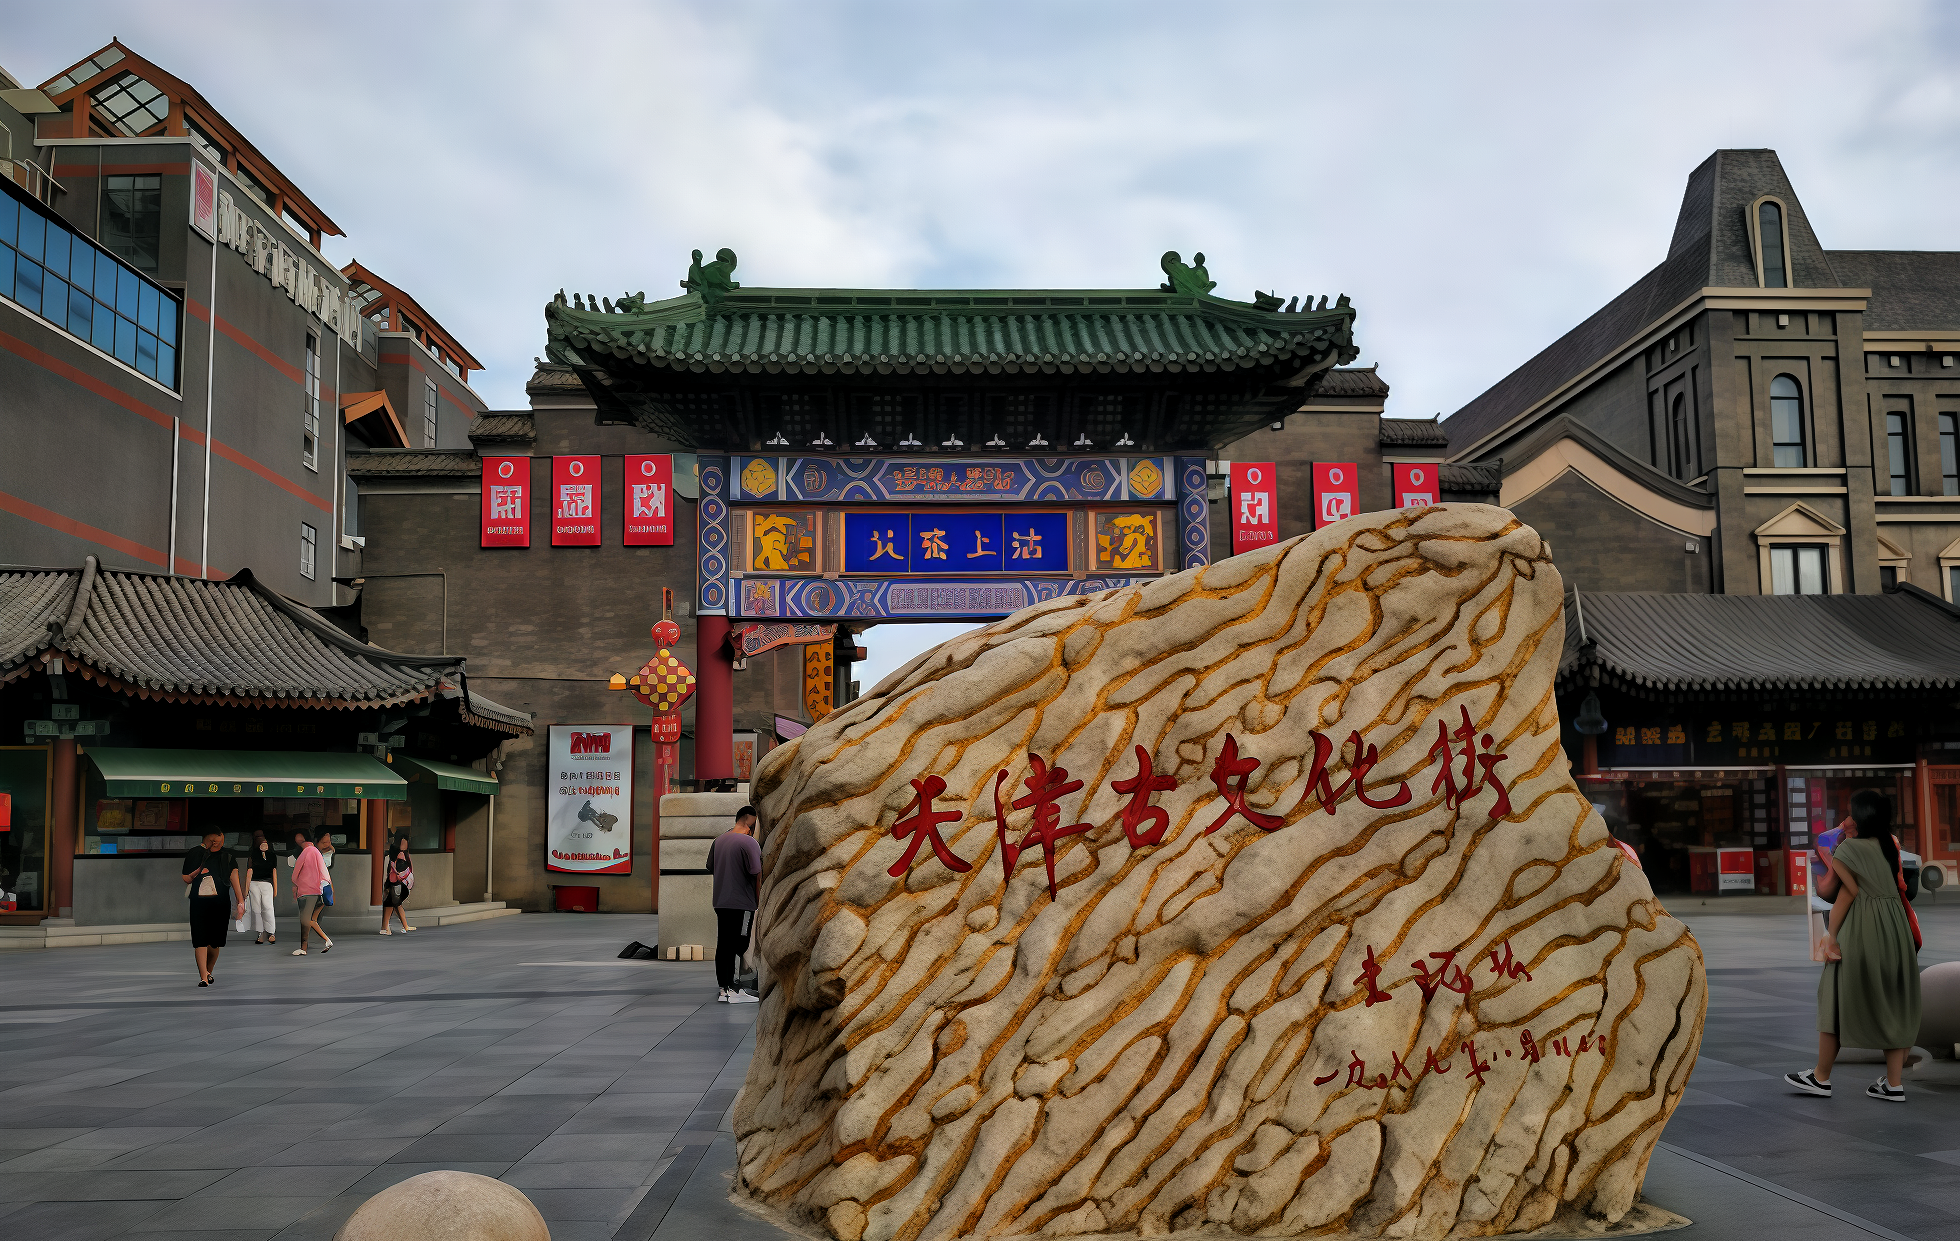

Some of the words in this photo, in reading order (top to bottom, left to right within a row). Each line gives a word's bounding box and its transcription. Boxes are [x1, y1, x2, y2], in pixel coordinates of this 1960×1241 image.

[887, 704, 1512, 902] 天津古文化街
